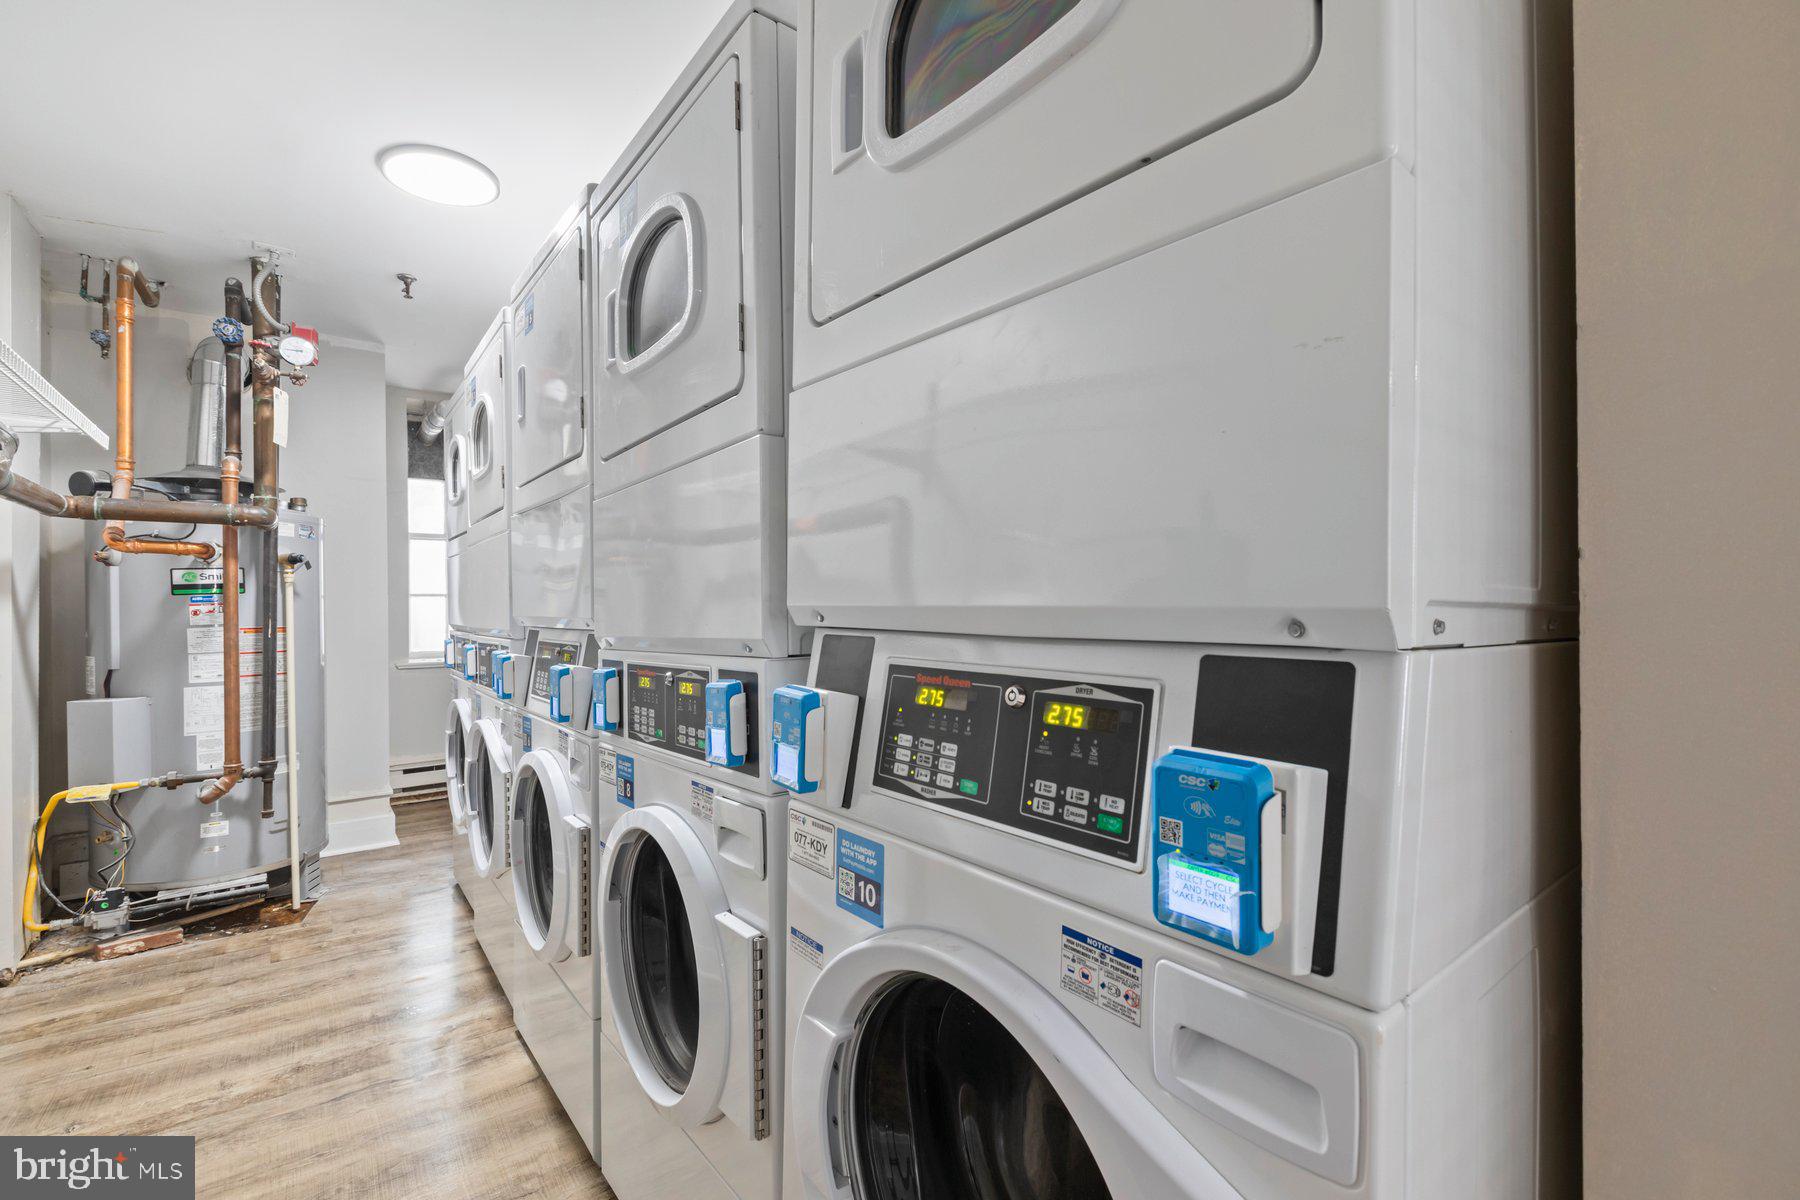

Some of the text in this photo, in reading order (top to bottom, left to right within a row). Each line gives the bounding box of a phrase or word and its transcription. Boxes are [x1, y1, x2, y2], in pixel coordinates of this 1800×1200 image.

[915, 673, 972, 688] Speed Queen
[1075, 687, 1094, 696] DRYER
[1047, 703, 1084, 729] 2.75
[1178, 774, 1206, 787] CSC
[626, 782, 631, 798] 8
[920, 787, 937, 796] WASHER
[794, 831, 828, 856] 077-KDY
[841, 839, 876, 857] DO LAUNDRY
[840, 847, 853, 858] WITH
[854, 851, 866, 863] THE
[865, 855, 878, 867] APP
[1175, 870, 1203, 885] SELECT
[1205, 879, 1231, 895] CYCLE
[858, 880, 877, 908] 10
[1183, 883, 1226, 902] AND THEN
[795, 930, 818, 949] NOTICE
[1086, 937, 1115, 955] NOTICE
